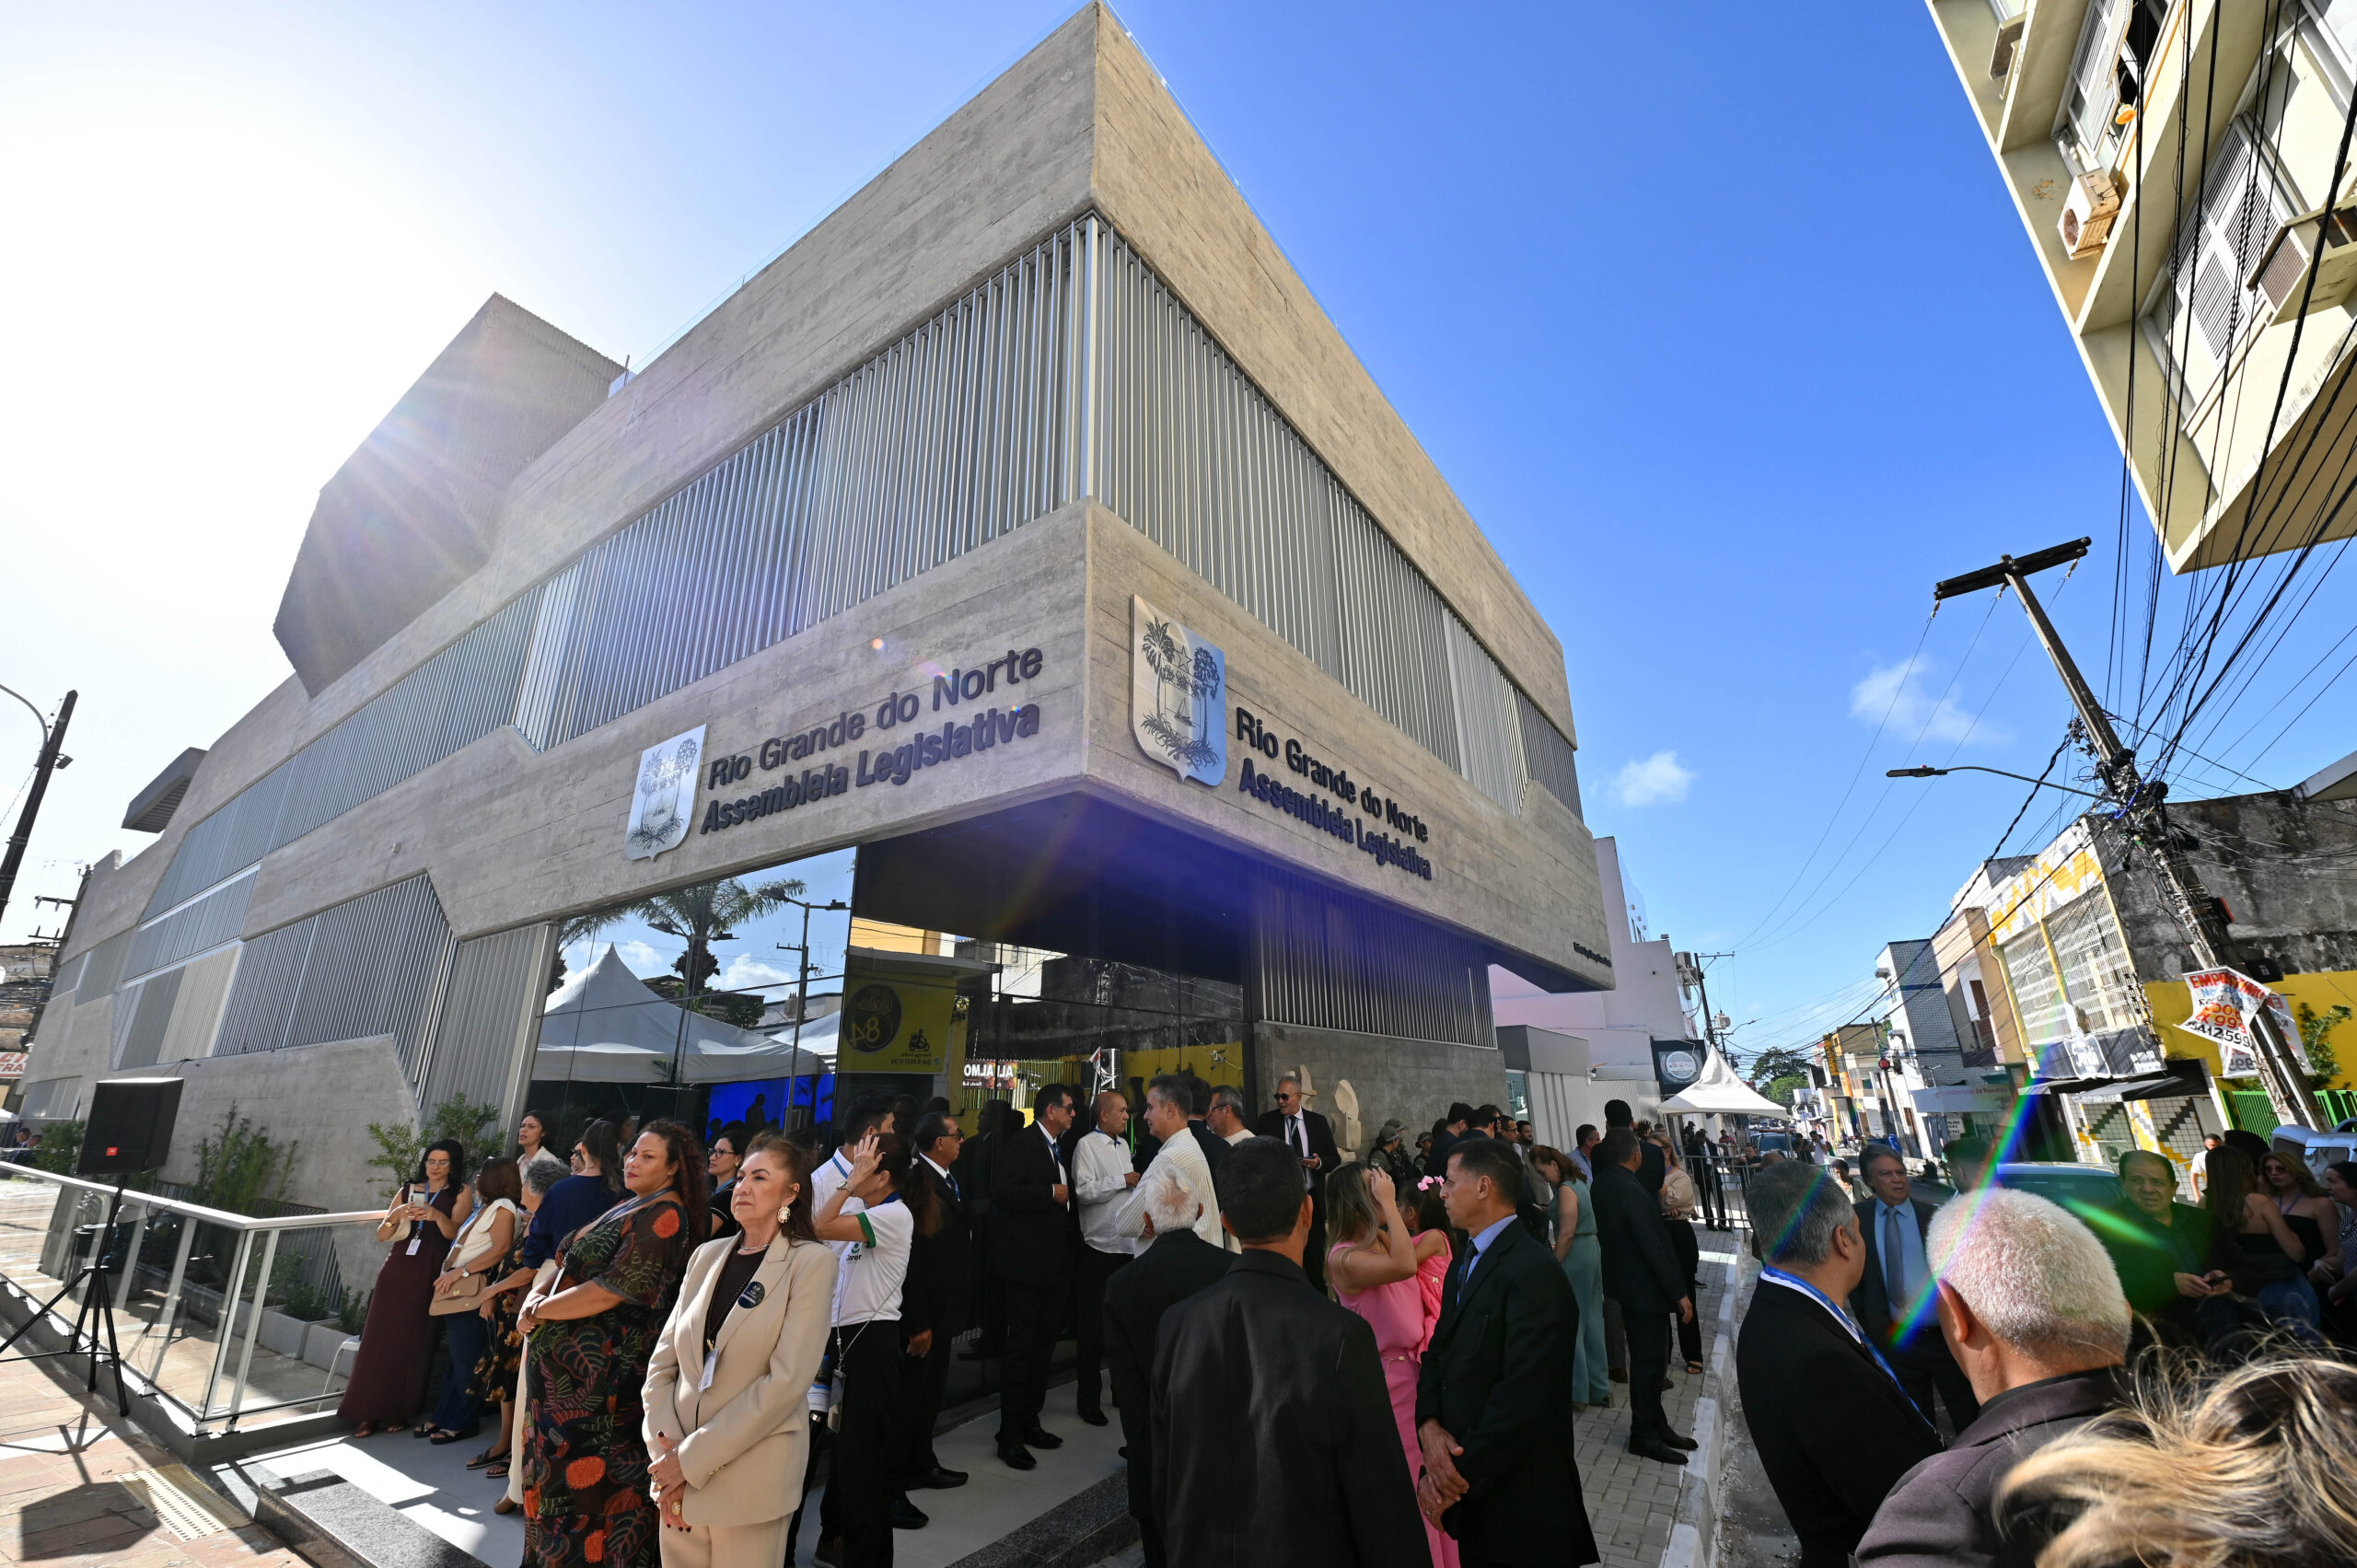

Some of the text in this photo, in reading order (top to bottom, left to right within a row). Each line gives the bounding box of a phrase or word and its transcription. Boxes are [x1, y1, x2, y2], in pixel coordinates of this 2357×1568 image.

[700, 703, 1040, 834] Assembleia Legislativa
[708, 648, 1043, 790] Rio Grande do Norte
[1237, 707, 1428, 842] Rio Grande do Norte
[1239, 758, 1432, 881] Assembleia Legislativa
